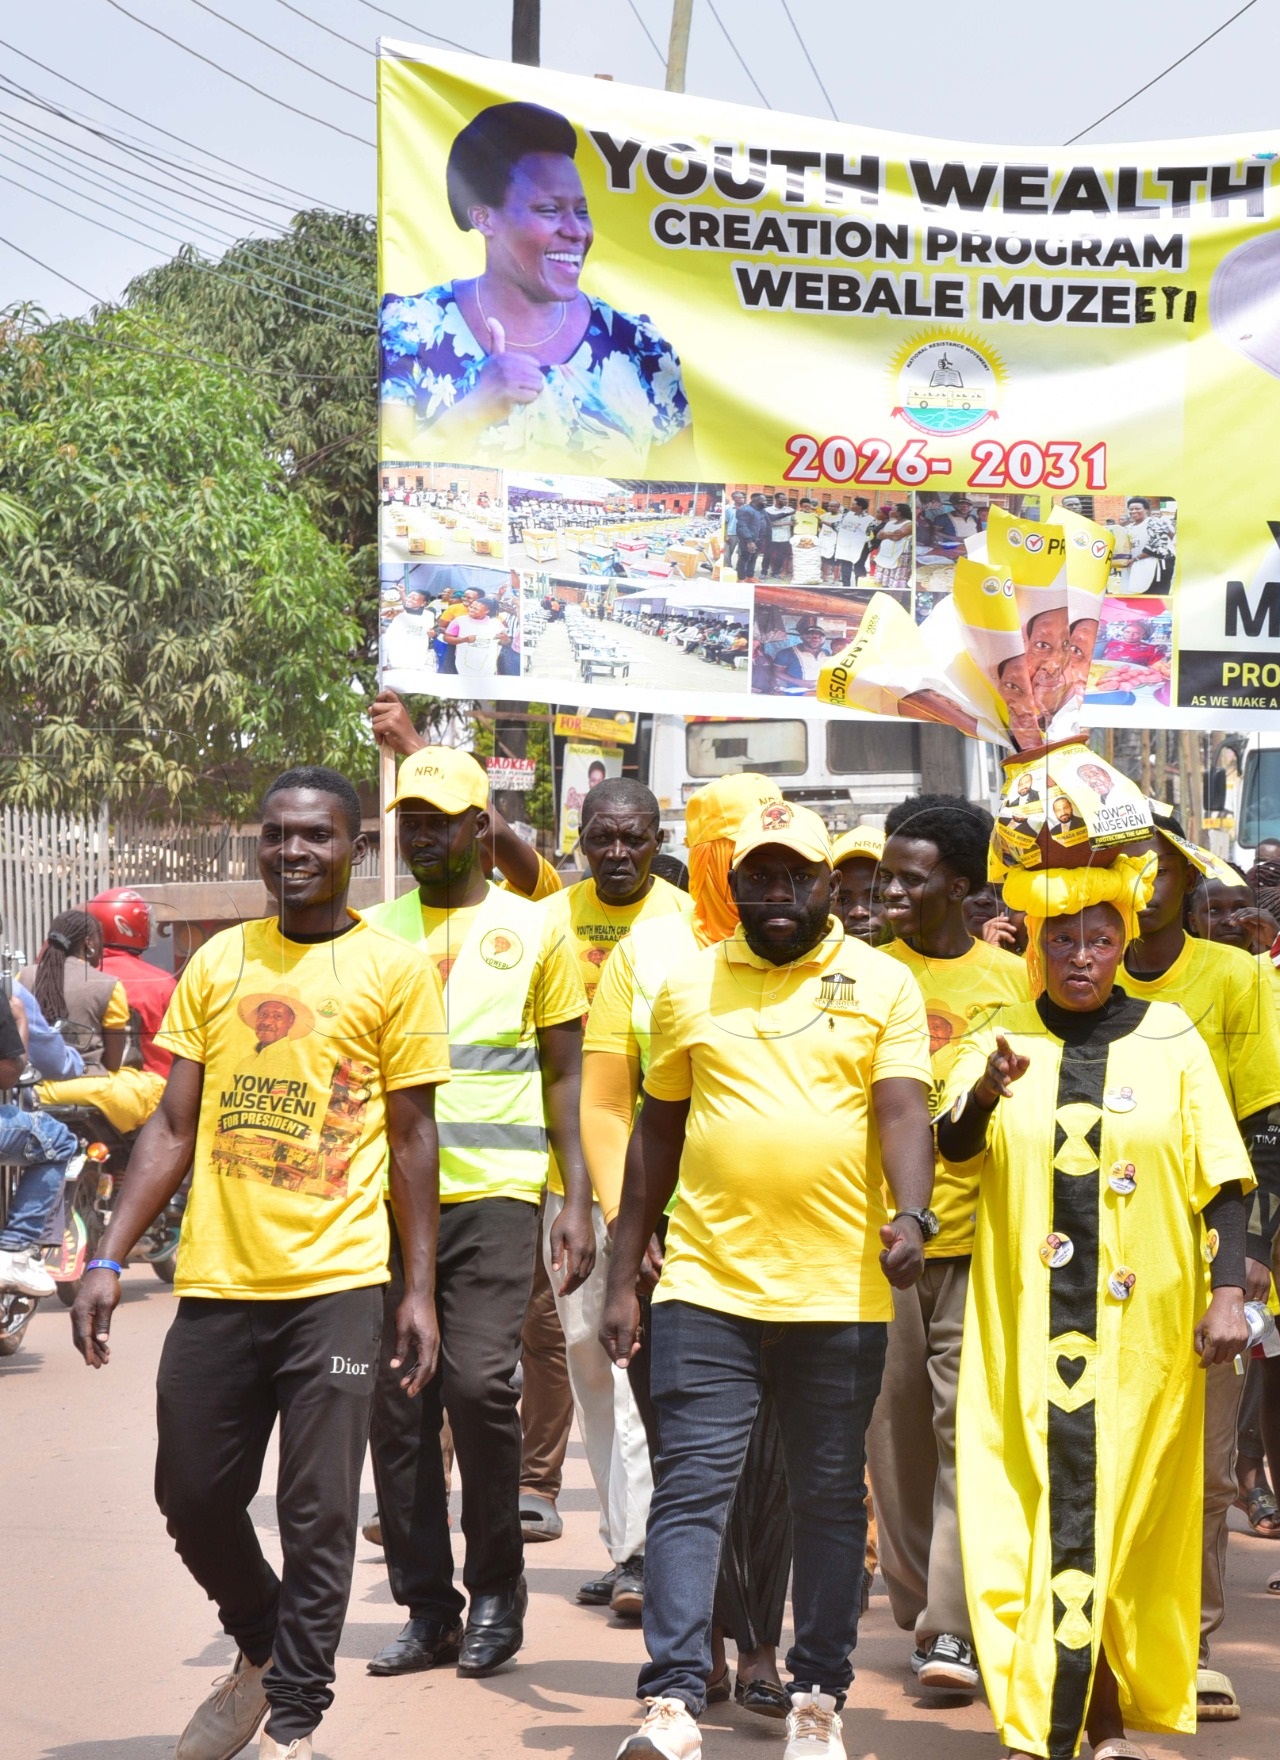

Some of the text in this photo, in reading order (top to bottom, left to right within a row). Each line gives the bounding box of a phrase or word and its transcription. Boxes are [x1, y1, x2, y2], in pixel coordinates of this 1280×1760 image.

[589, 130, 1266, 220] YOUTH WEALTH
[654, 209, 1183, 269] CREATION PROGRAM
[736, 267, 964, 318] WEBALE
[906, 341, 990, 372] NATIONAL RESISTANCE MOVEMENT
[968, 440, 1107, 489] 2031
[1191, 695, 1208, 706] AS
[1209, 696, 1229, 707] WE
[1231, 697, 1267, 708] MAKE
[1269, 697, 1279, 708] A
[486, 756, 535, 771] BROKER
[1092, 814, 1147, 834] MUSEVENI
[1094, 803, 1138, 822] YOWERI
[577, 924, 594, 935] YOUTH
[594, 924, 616, 935] WEALTH
[233, 1074, 308, 1099] YOWERI
[219, 1090, 317, 1118] MUSEVENI
[222, 1111, 306, 1137] FOR PRESIDENT
[1255, 1134, 1277, 1145] TIM
[330, 1356, 369, 1375] Dior
